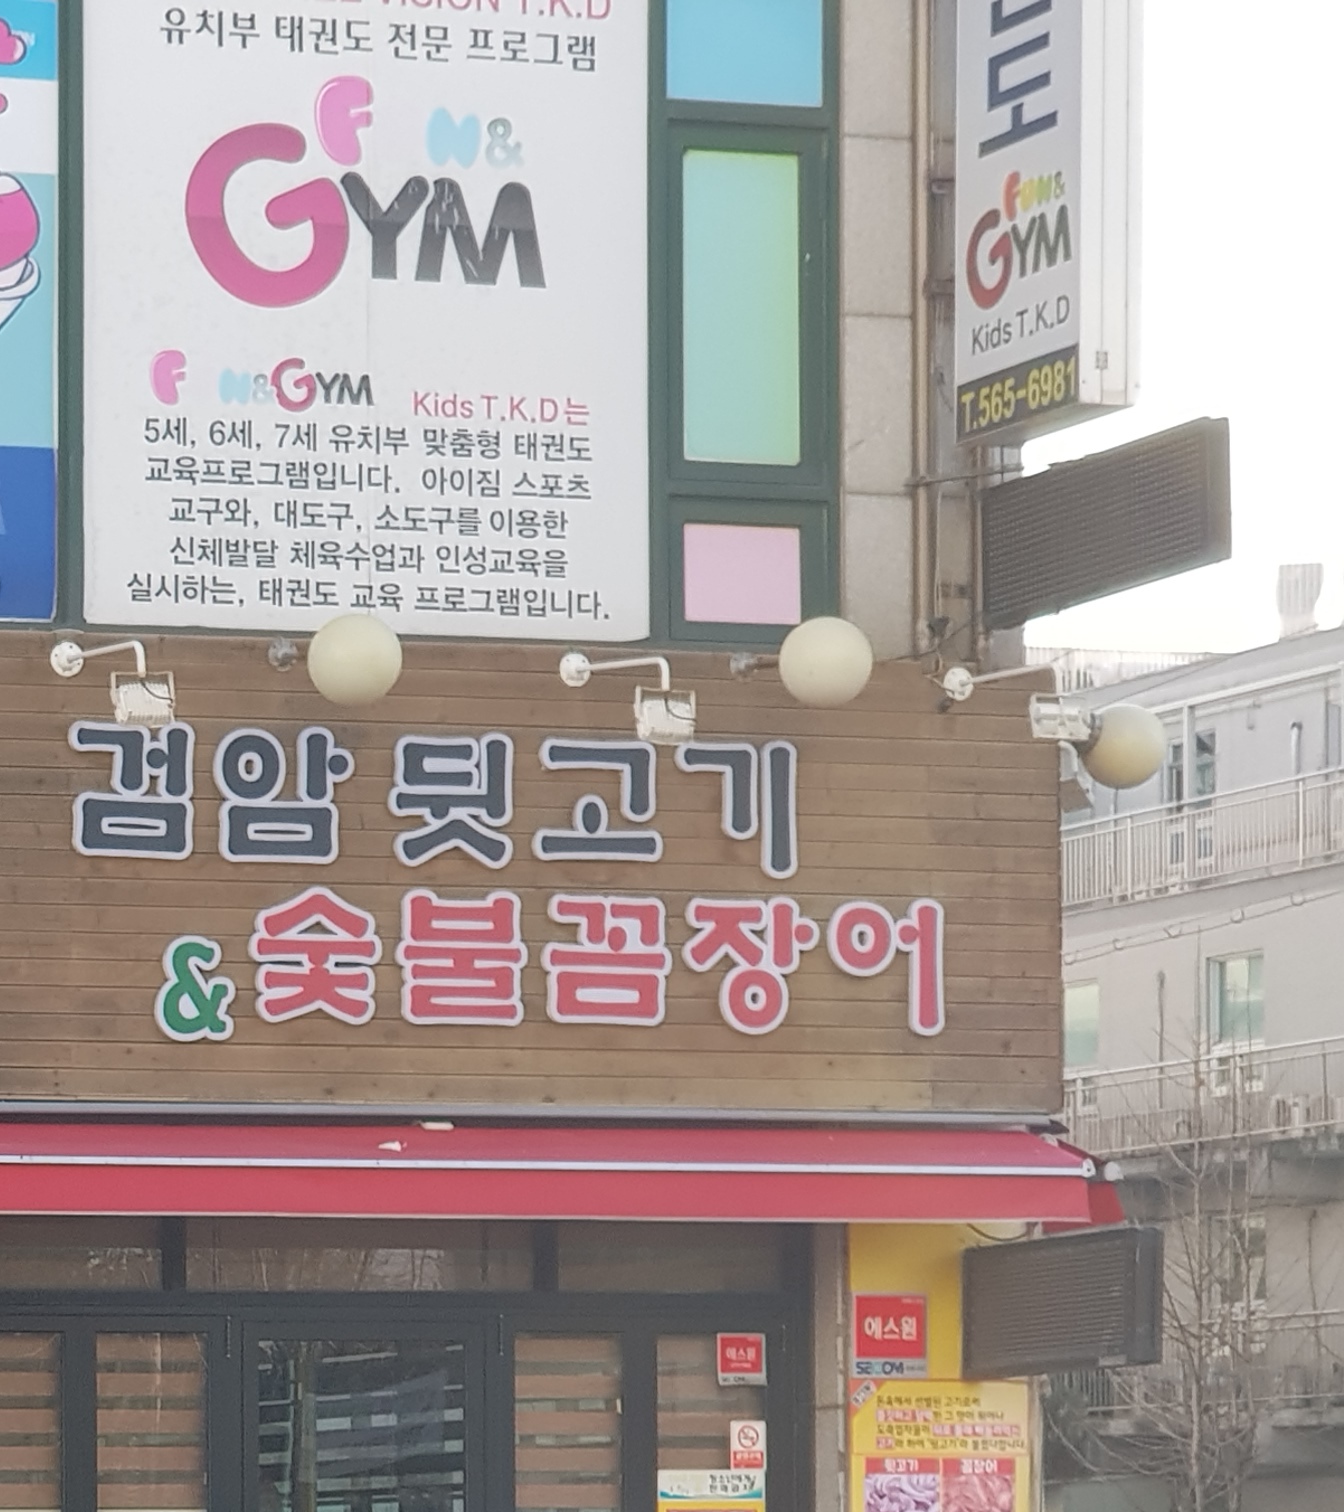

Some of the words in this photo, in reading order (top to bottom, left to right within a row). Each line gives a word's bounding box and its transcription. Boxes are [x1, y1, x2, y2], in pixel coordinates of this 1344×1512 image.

[161, 7, 261, 50] 유치부
[275, 14, 373, 55] 태권도
[387, 22, 452, 62] 전문
[466, 27, 597, 73] 프로그램
[185, 122, 546, 308] GYM
[966, 204, 1071, 310] GYM
[971, 317, 1013, 355] Kids
[1016, 295, 1070, 339] T.K.D
[412, 390, 475, 420] Kids
[143, 417, 197, 448] 5세,
[208, 422, 261, 452] 6세,
[274, 422, 318, 452] 7세
[329, 426, 410, 455] 유치부
[423, 429, 503, 460] 맞춤형
[514, 434, 593, 463] 태권도
[145, 455, 401, 495] 교육프로그램입니다.
[420, 467, 502, 499] 아이짐
[513, 471, 592, 500] 스포츠
[168, 496, 260, 530] 교구와,
[274, 501, 363, 533] 대도구,
[374, 505, 483, 536] 소도구를
[488, 509, 569, 540] 이용한
[170, 536, 278, 569] 신체발달
[290, 541, 425, 574] 체육수업과
[436, 547, 569, 579] 인성교육을
[126, 574, 245, 608] 실시하는,
[259, 578, 340, 609] 태권도
[349, 582, 404, 613] 교육
[414, 586, 611, 621] 프로그램입니다.
[68, 719, 355, 863] 검암
[388, 731, 798, 879] 뒷고기
[156, 934, 236, 1042] &
[249, 887, 944, 1036] 숯불꼼장어
[864, 1316, 918, 1341] 에스원
